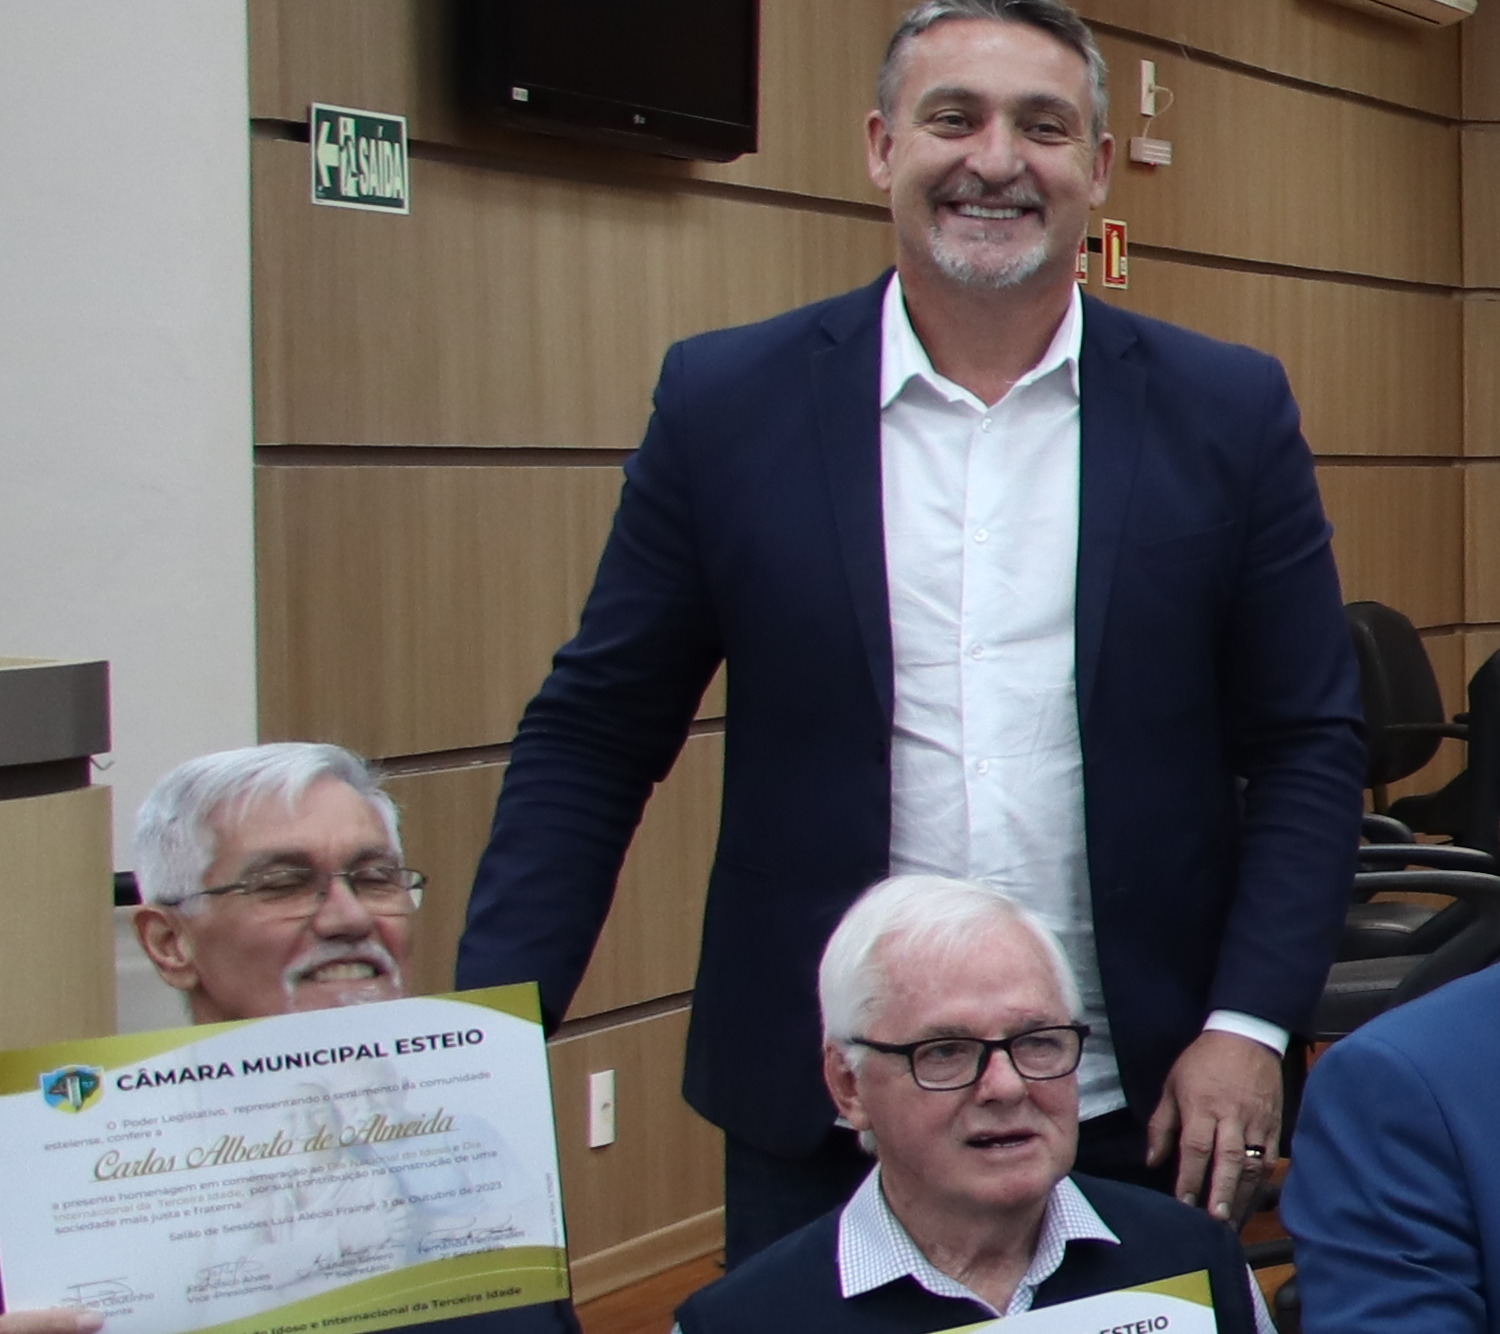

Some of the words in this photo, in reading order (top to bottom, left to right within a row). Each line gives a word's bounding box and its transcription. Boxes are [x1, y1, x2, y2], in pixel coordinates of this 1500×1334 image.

[359, 126, 404, 199] SAÍDA
[116, 1062, 235, 1091] CÂMARA
[241, 1041, 389, 1075] MUNICIPAL
[395, 1028, 484, 1055] ESTEIO
[93, 1147, 177, 1181] Carlos
[186, 1129, 293, 1169] Alberto
[303, 1124, 334, 1153] de
[338, 1107, 456, 1147] Almeida
